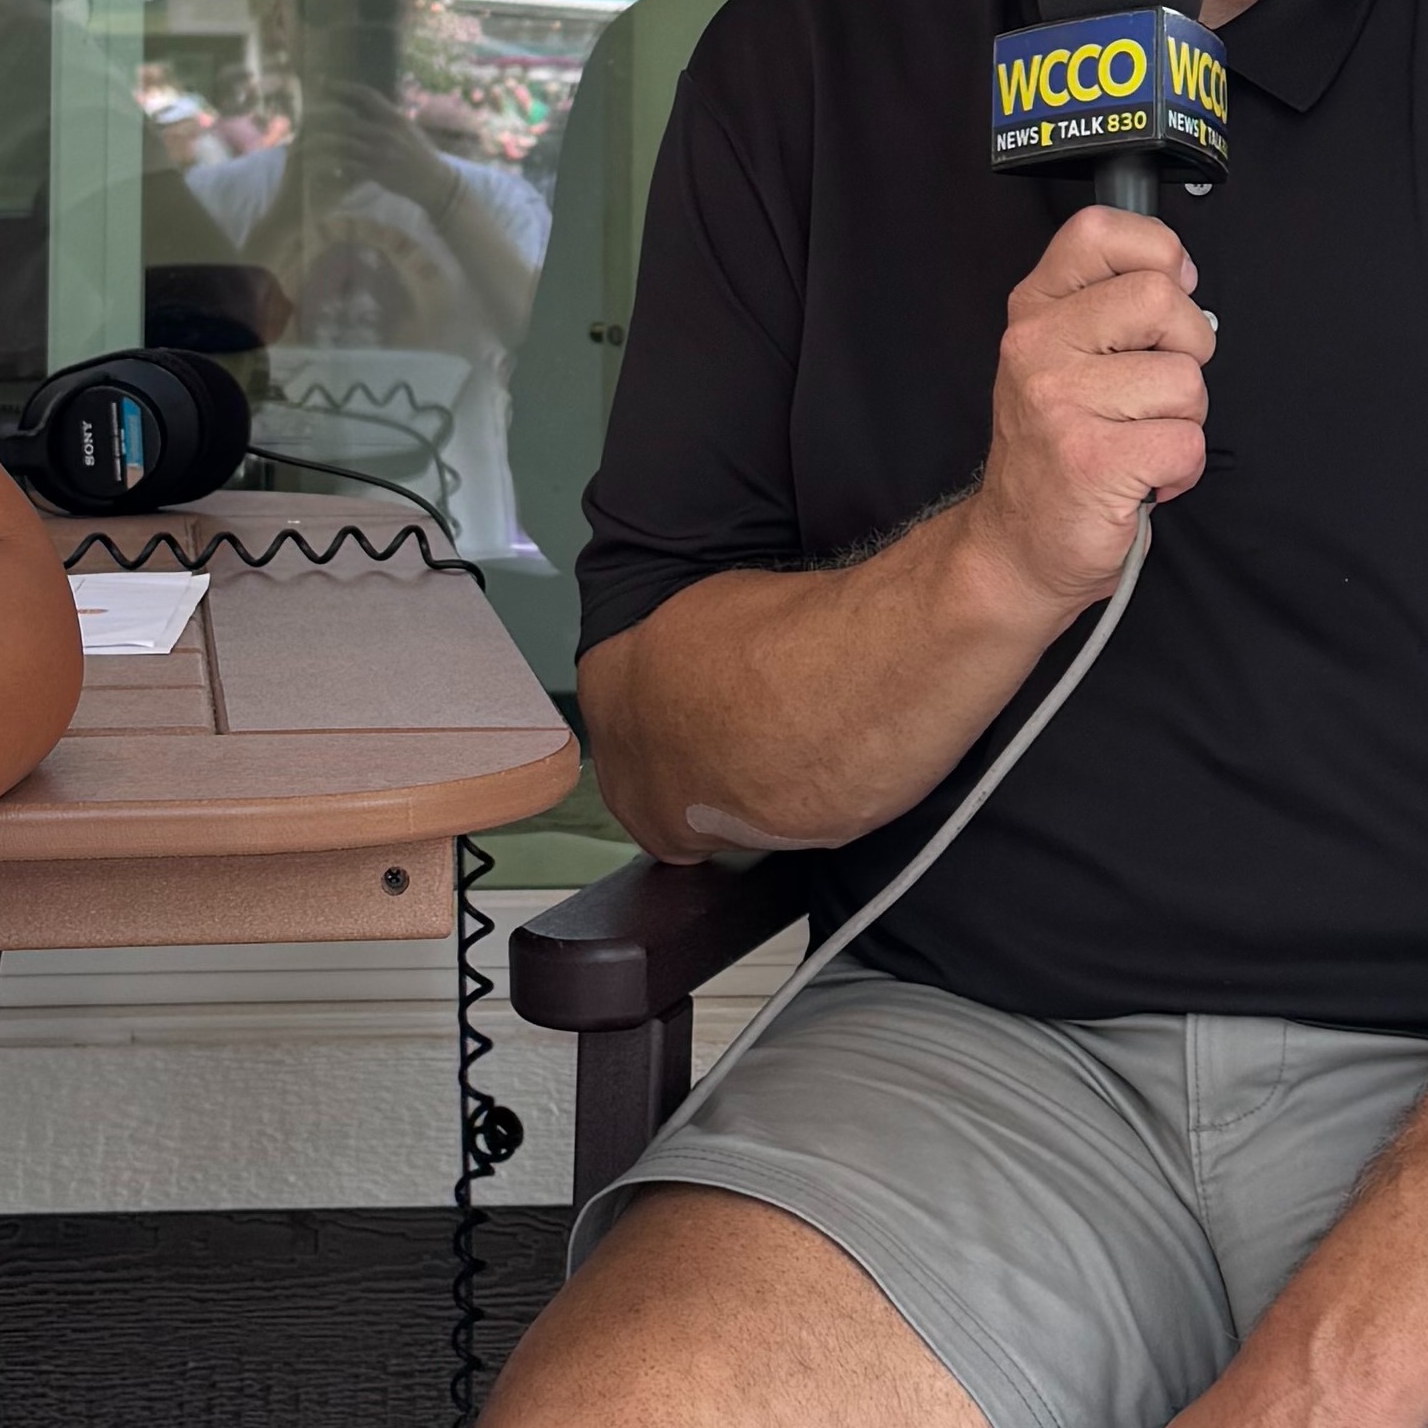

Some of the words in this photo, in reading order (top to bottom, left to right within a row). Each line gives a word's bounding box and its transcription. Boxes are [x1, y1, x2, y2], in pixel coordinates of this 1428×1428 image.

[998, 38, 1148, 116] WCCO
[1167, 35, 1228, 125] WCCO
[997, 125, 1039, 152] NEWS
[1058, 116, 1104, 139] TALK
[1107, 110, 1148, 133] 830
[1168, 109, 1200, 138] NEWS
[82, 420, 95, 466] SONY
